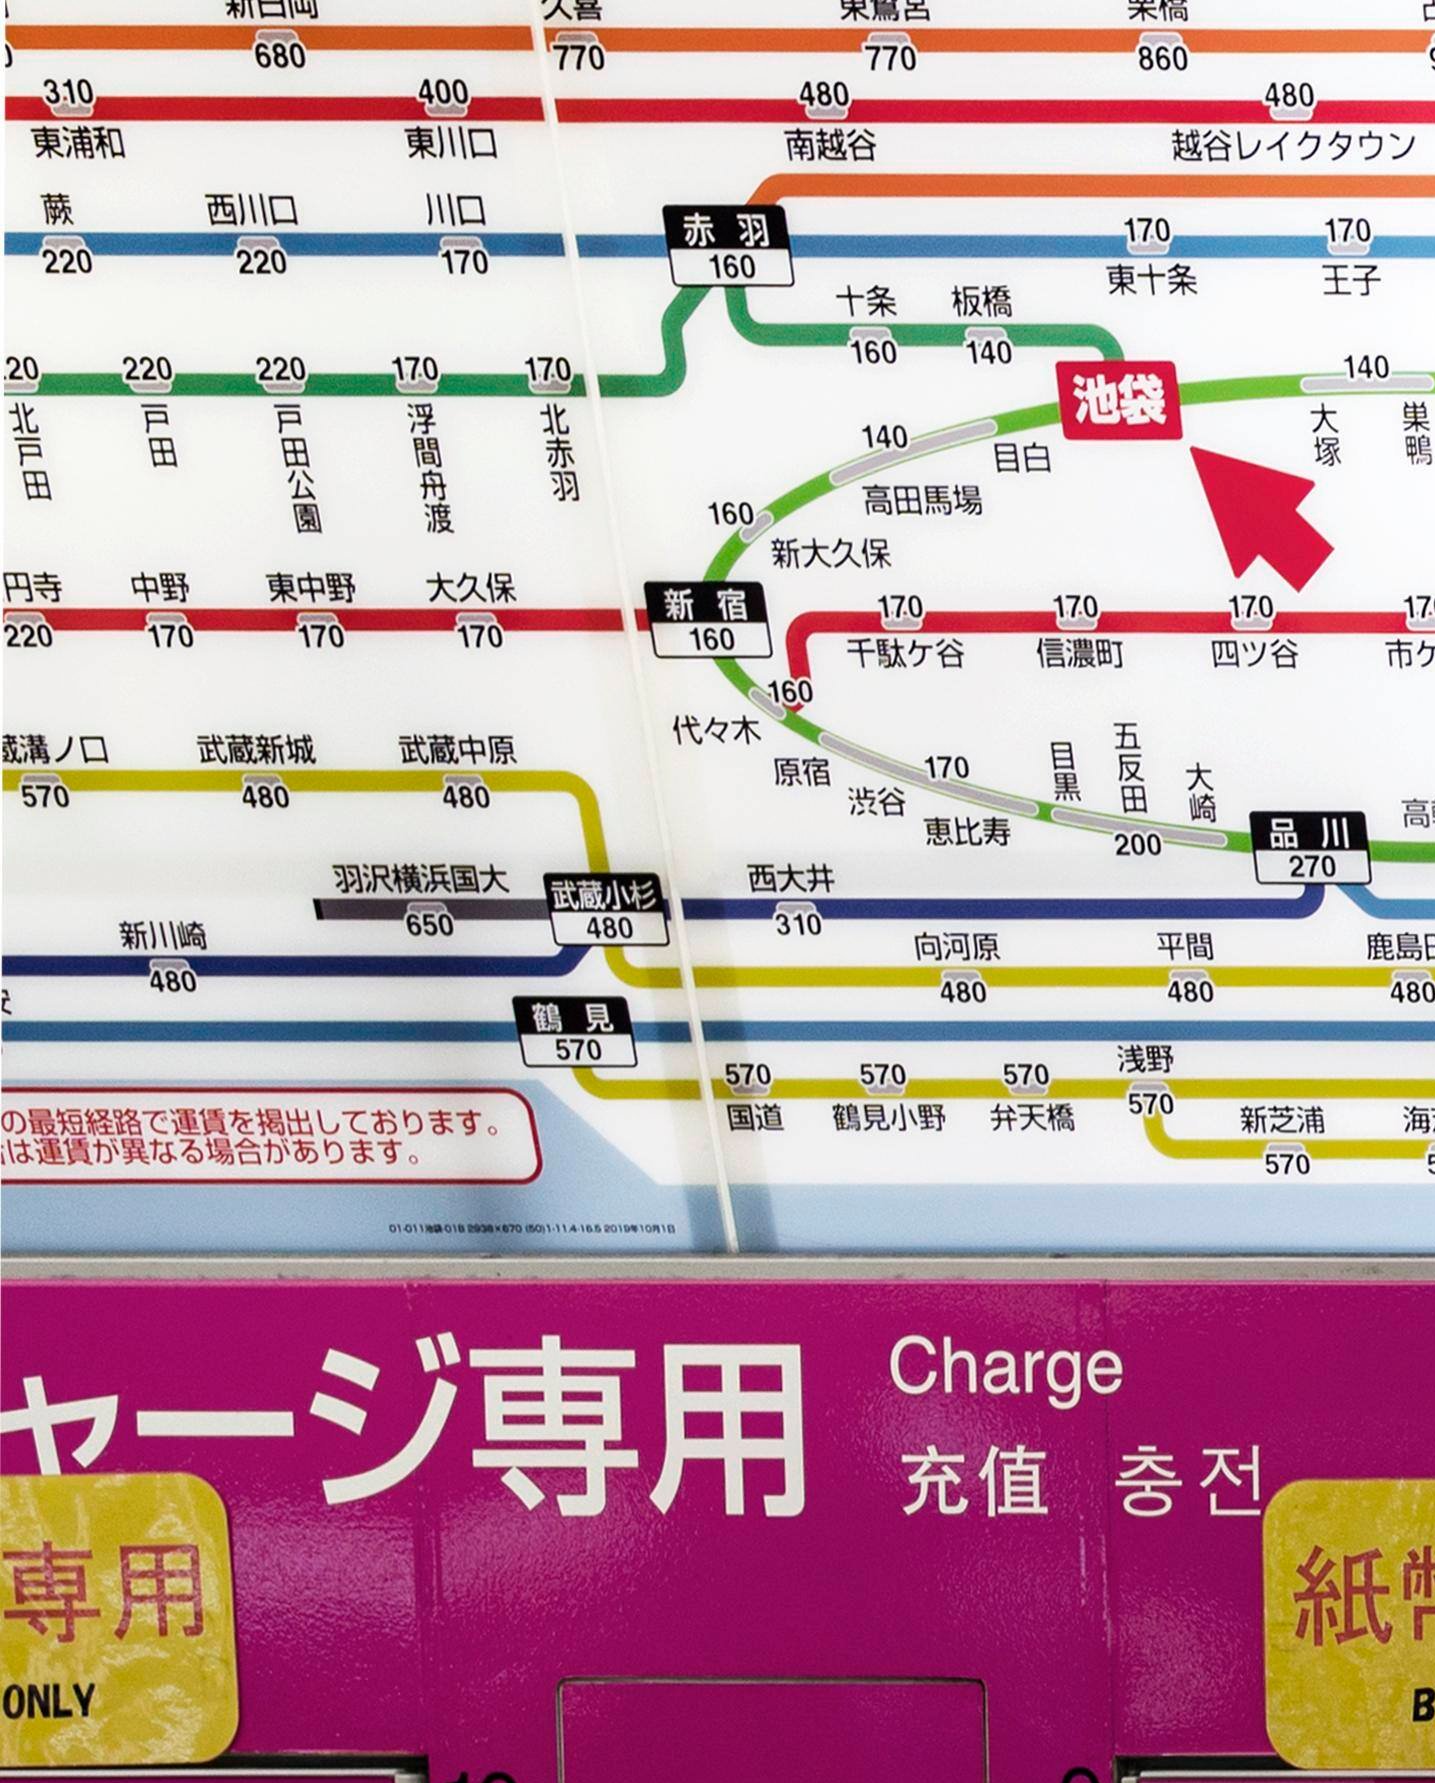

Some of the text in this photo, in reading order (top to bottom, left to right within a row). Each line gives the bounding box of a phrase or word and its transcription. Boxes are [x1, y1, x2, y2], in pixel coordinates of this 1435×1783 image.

[1138, 45, 1188, 71] 860
[799, 81, 849, 107] 480
[30, 125, 126, 159] 東浦和
[404, 125, 498, 160] 東川口
[783, 127, 877, 162] 南越谷
[1171, 129, 1415, 162] 越谷レイクタウン
[204, 193, 298, 227] 西川口
[236, 249, 287, 275] 220
[441, 249, 489, 275] 170
[1106, 263, 1198, 296] 東十条
[1073, 373, 1167, 425] 池袋
[273, 404, 323, 534] 戸田公園
[407, 403, 455, 534] 浮間舟渡
[862, 484, 983, 516] 高田馬場
[771, 538, 892, 569] 新大久保
[265, 571, 356, 604] 東中野
[1036, 637, 1123, 669] 信濃町
[1211, 638, 1298, 669] 四ツ谷
[196, 734, 317, 765] 武蔵新城
[398, 734, 518, 765] 武蔵中原
[332, 863, 510, 894] 羽沢横浜国大
[551, 880, 656, 910] 武蔵小杉
[119, 920, 208, 951] 新川崎
[1117, 1044, 1174, 1074] 浅野
[1, 1107, 500, 1139] の最短経路で運賃を掲出しております。
[832, 1103, 946, 1132] 鶴見小野
[1240, 1105, 1325, 1134] 新芝浦
[890, 1334, 1123, 1410] Charge
[901, 1444, 1261, 1518] 充值 충전
[2, 1682, 96, 1720] ONLY
